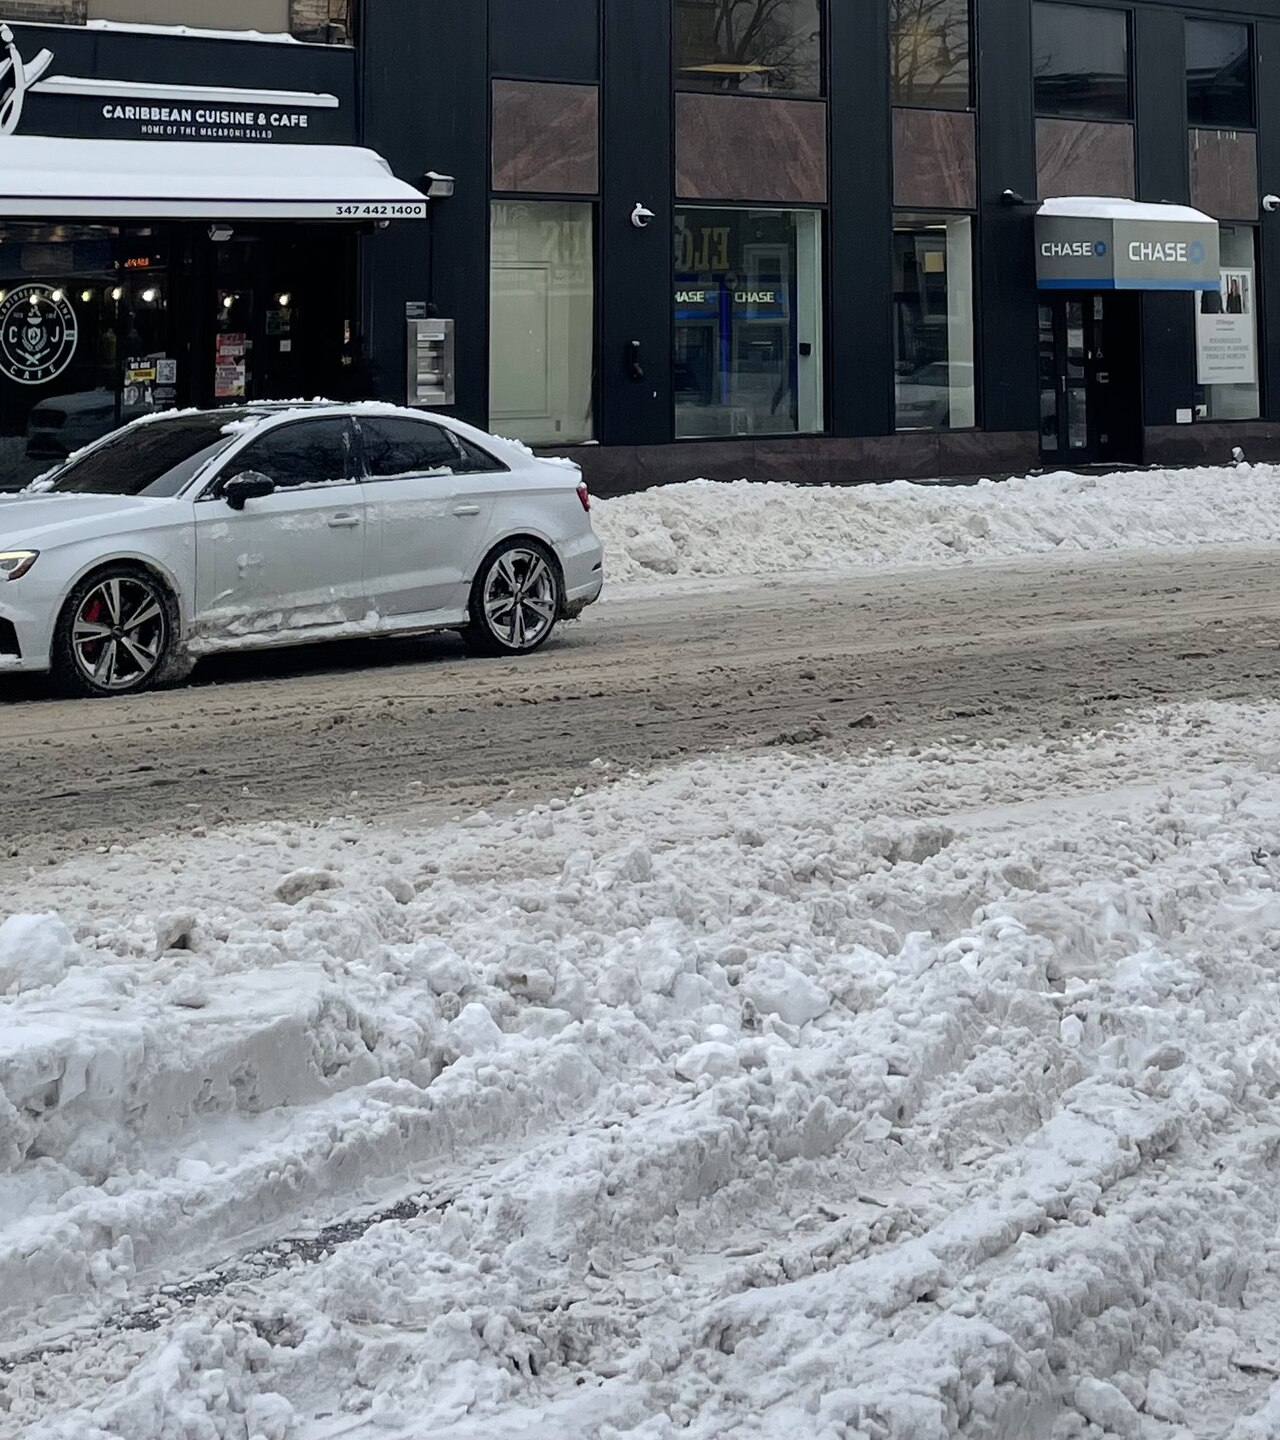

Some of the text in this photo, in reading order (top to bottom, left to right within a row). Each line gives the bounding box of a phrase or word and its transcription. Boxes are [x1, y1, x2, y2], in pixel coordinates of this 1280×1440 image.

[102, 105, 308, 127] CARIBBEAN CUISINE & CAFE
[141, 125, 272, 138] HOME OF THE MACARONI SALAD
[336, 206, 421, 215] 347 442 1400
[1041, 242, 1092, 256] CHASE
[1128, 241, 1188, 262] CHASE
[735, 291, 775, 303] CHASE
[8, 326, 60, 343] C J
[10, 364, 56, 379] CAFE
